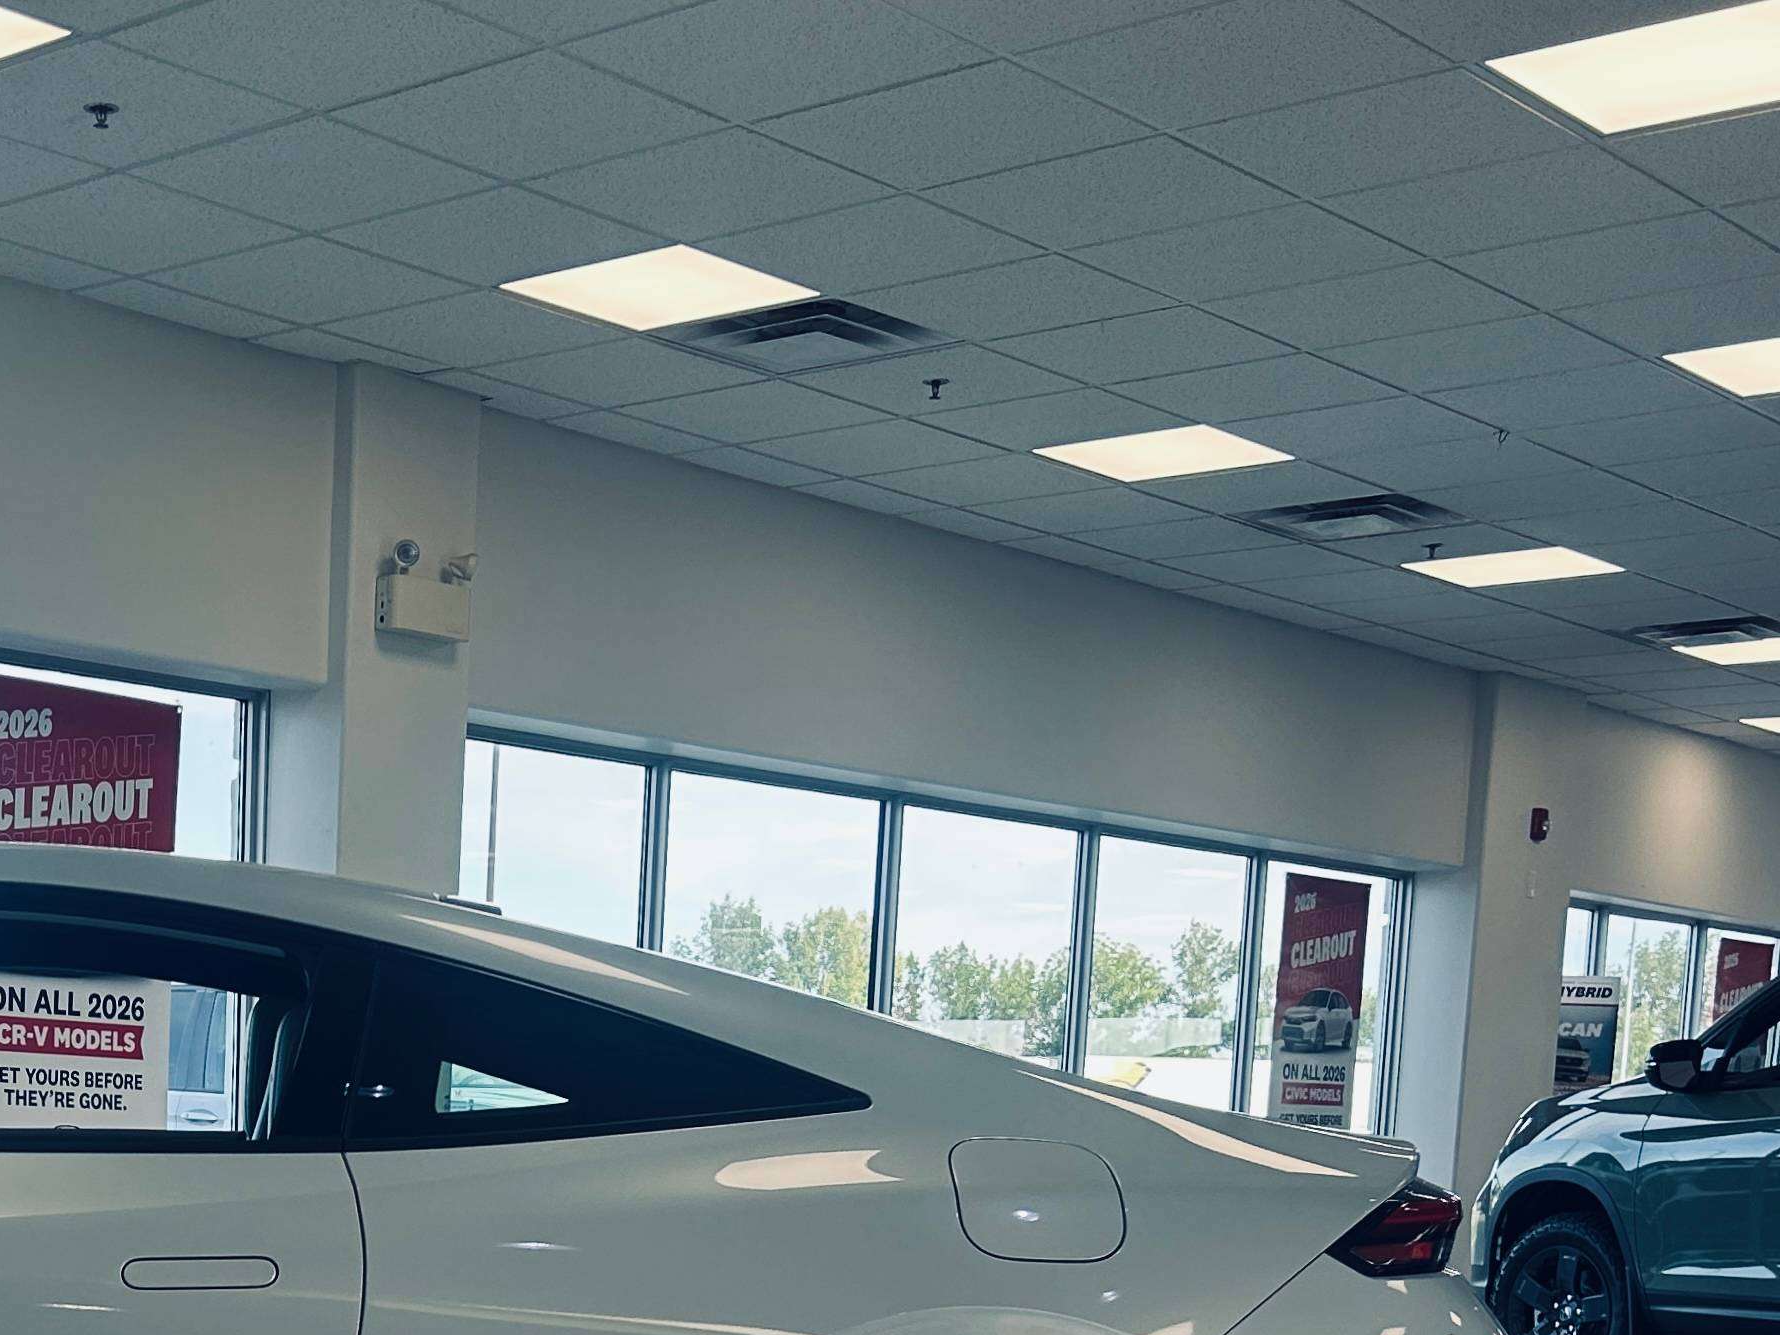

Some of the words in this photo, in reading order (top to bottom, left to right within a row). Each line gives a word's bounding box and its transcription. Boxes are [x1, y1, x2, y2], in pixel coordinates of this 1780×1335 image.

[1290, 929, 1357, 969] CLEAROUT
[34, 989, 81, 1017] ALL
[88, 993, 145, 1022] 2026
[54, 1027, 136, 1053] MODELS
[25, 1068, 80, 1088] YOURS
[85, 1072, 143, 1091] BEFORE
[1283, 1063, 1299, 1080] ON
[1301, 1064, 1321, 1080] ALL
[1322, 1066, 1346, 1082] 2026
[4, 1089, 75, 1109] THEY'RE
[79, 1093, 128, 1112] GONE.
[1285, 1087, 1308, 1100] CIVIC
[1310, 1088, 1341, 1102] MODELS
